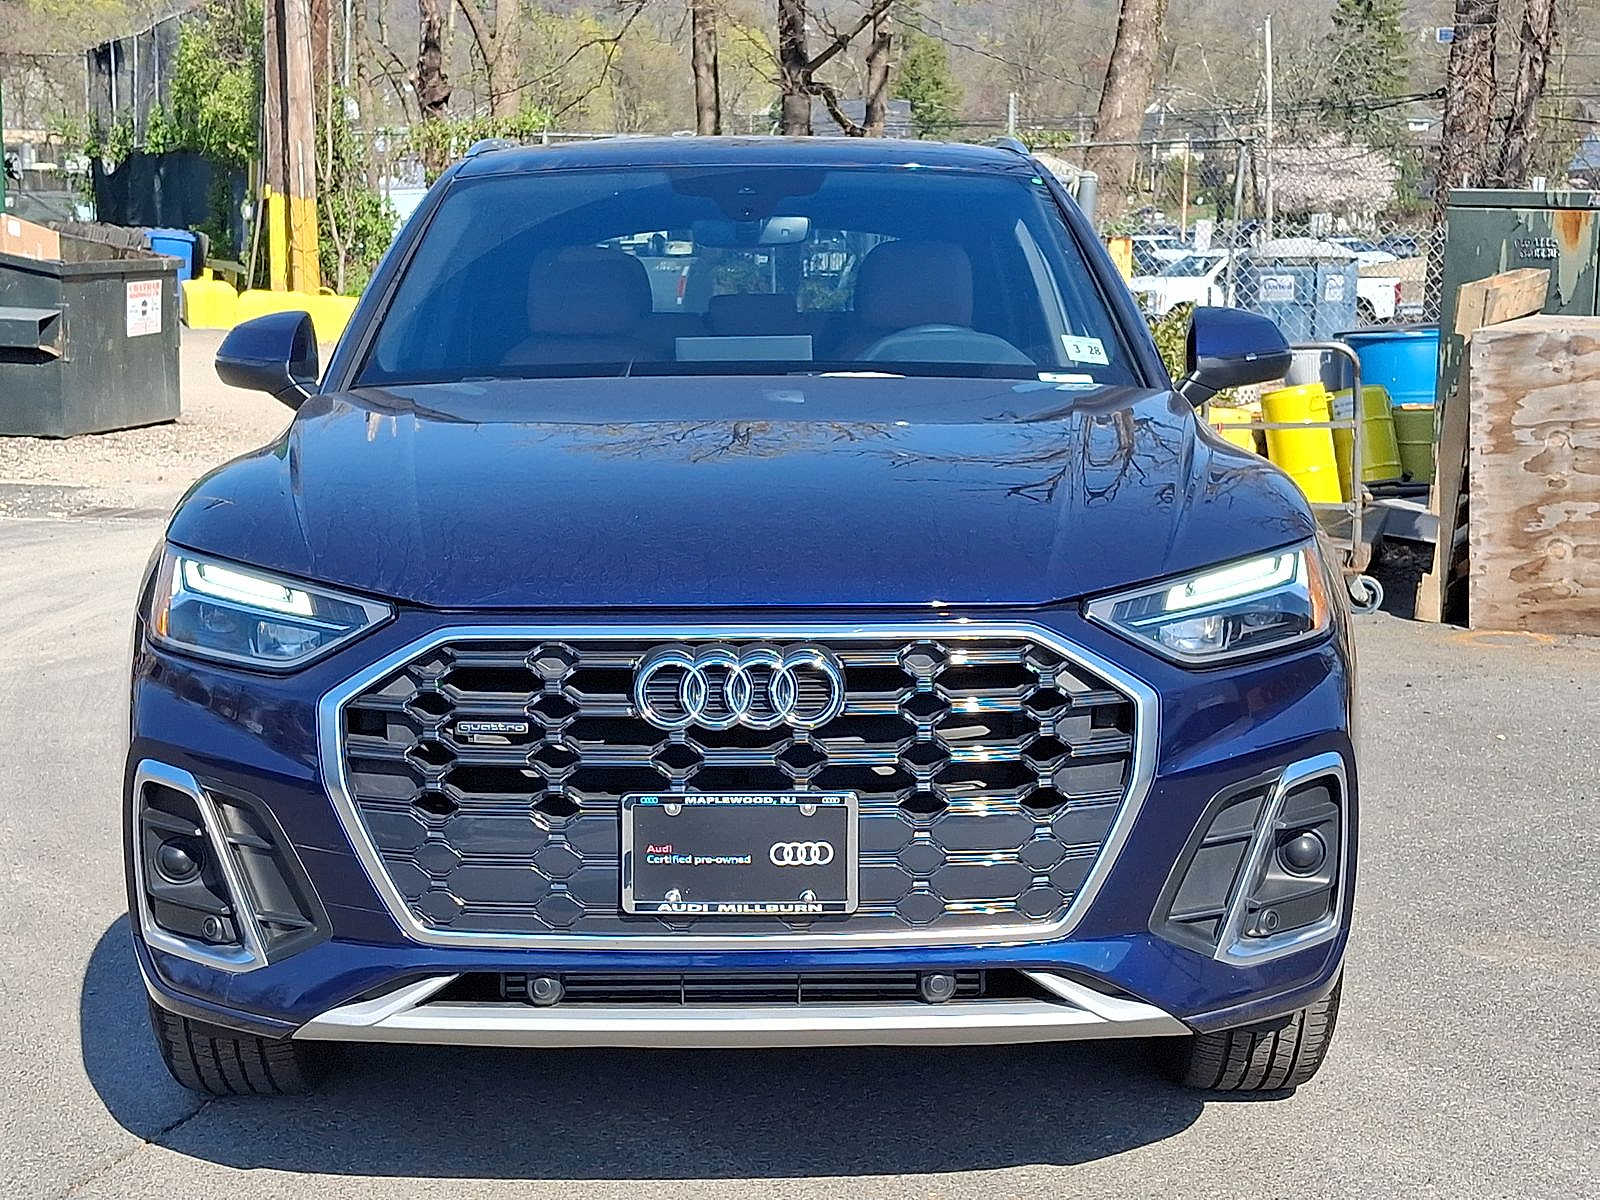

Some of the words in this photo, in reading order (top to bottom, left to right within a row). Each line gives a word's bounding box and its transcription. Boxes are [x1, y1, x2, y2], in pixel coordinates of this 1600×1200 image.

[1073, 344, 1081, 353] 3
[1088, 345, 1102, 355] 28
[459, 722, 526, 733] quattro
[684, 796, 777, 805] MAPLEWOOD,
[780, 796, 796, 804] NJ
[646, 844, 672, 854] Audi
[646, 854, 692, 864] Certified
[694, 854, 752, 866] pre-owned
[657, 903, 709, 912] AUDI
[717, 903, 823, 912] MILLBURN
